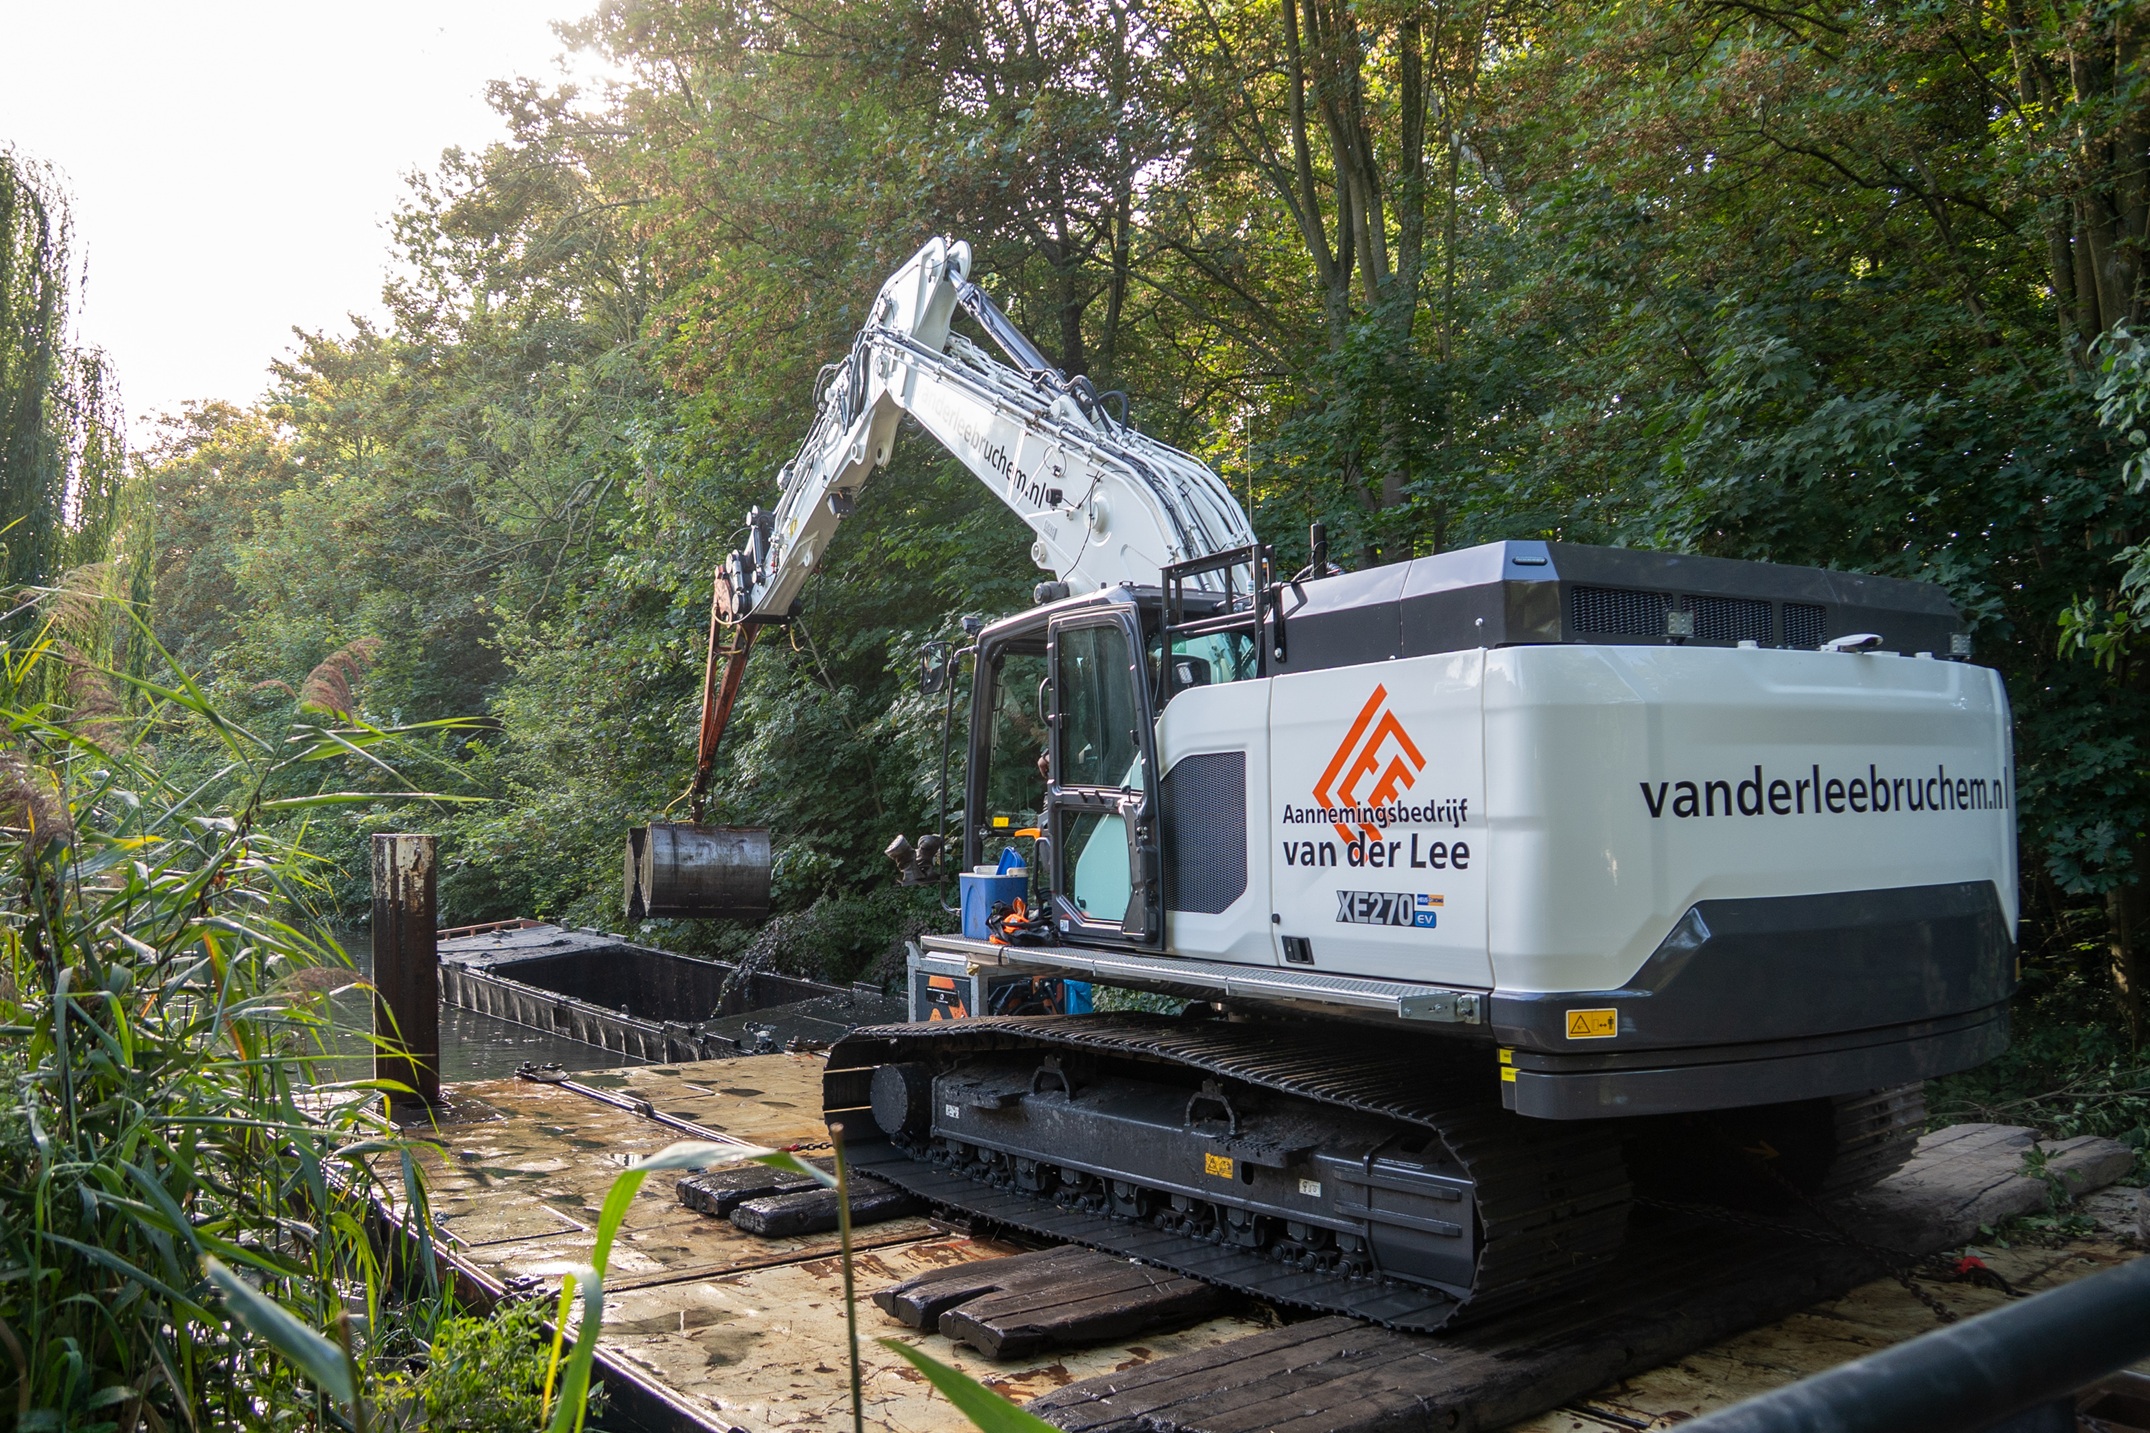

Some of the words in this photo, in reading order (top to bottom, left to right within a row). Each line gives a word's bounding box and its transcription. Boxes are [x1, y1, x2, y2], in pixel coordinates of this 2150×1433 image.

[1639, 763, 2009, 818] vanderleebruchem.nl
[1283, 798, 1468, 828] Aannemingsbedrijf
[1283, 841, 1337, 868] van
[1347, 831, 1401, 868] der
[1411, 833, 1470, 869] Lee
[1336, 890, 1414, 926] XE270
[1417, 914, 1433, 925] EV
